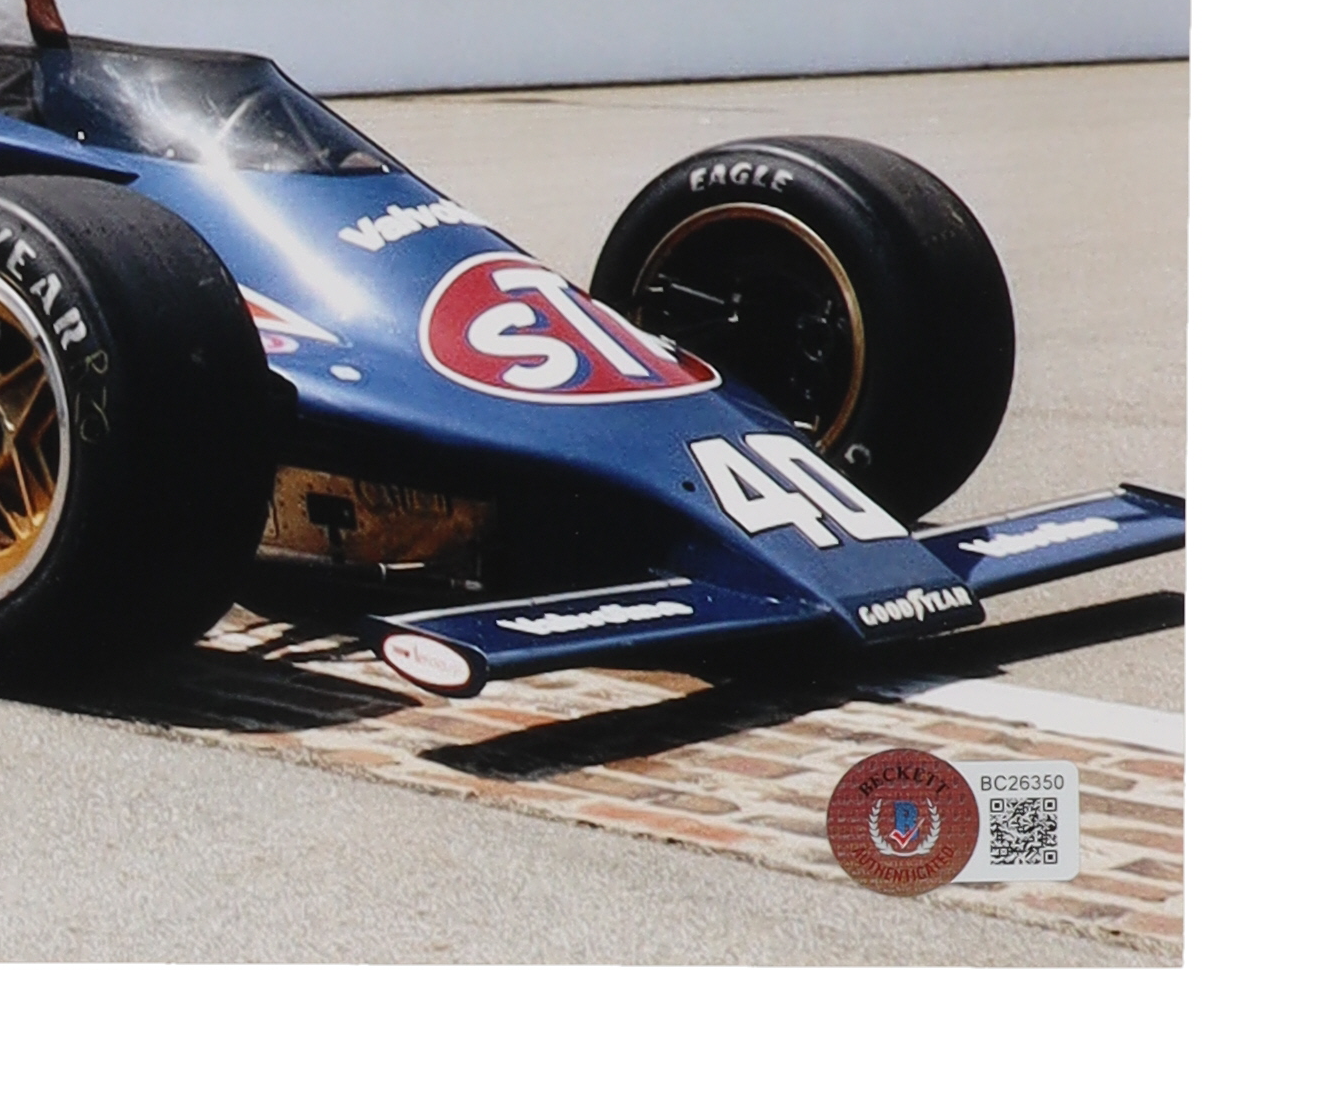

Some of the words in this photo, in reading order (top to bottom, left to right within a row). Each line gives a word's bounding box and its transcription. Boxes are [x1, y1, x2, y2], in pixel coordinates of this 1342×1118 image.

[690, 161, 794, 193] EAGLE
[690, 433, 909, 548] 40
[858, 586, 973, 626] GOODYEAR
[858, 765, 950, 798] BECKETT
[980, 774, 1065, 792] BC26350
[853, 845, 956, 882] AUTHENTICATED
